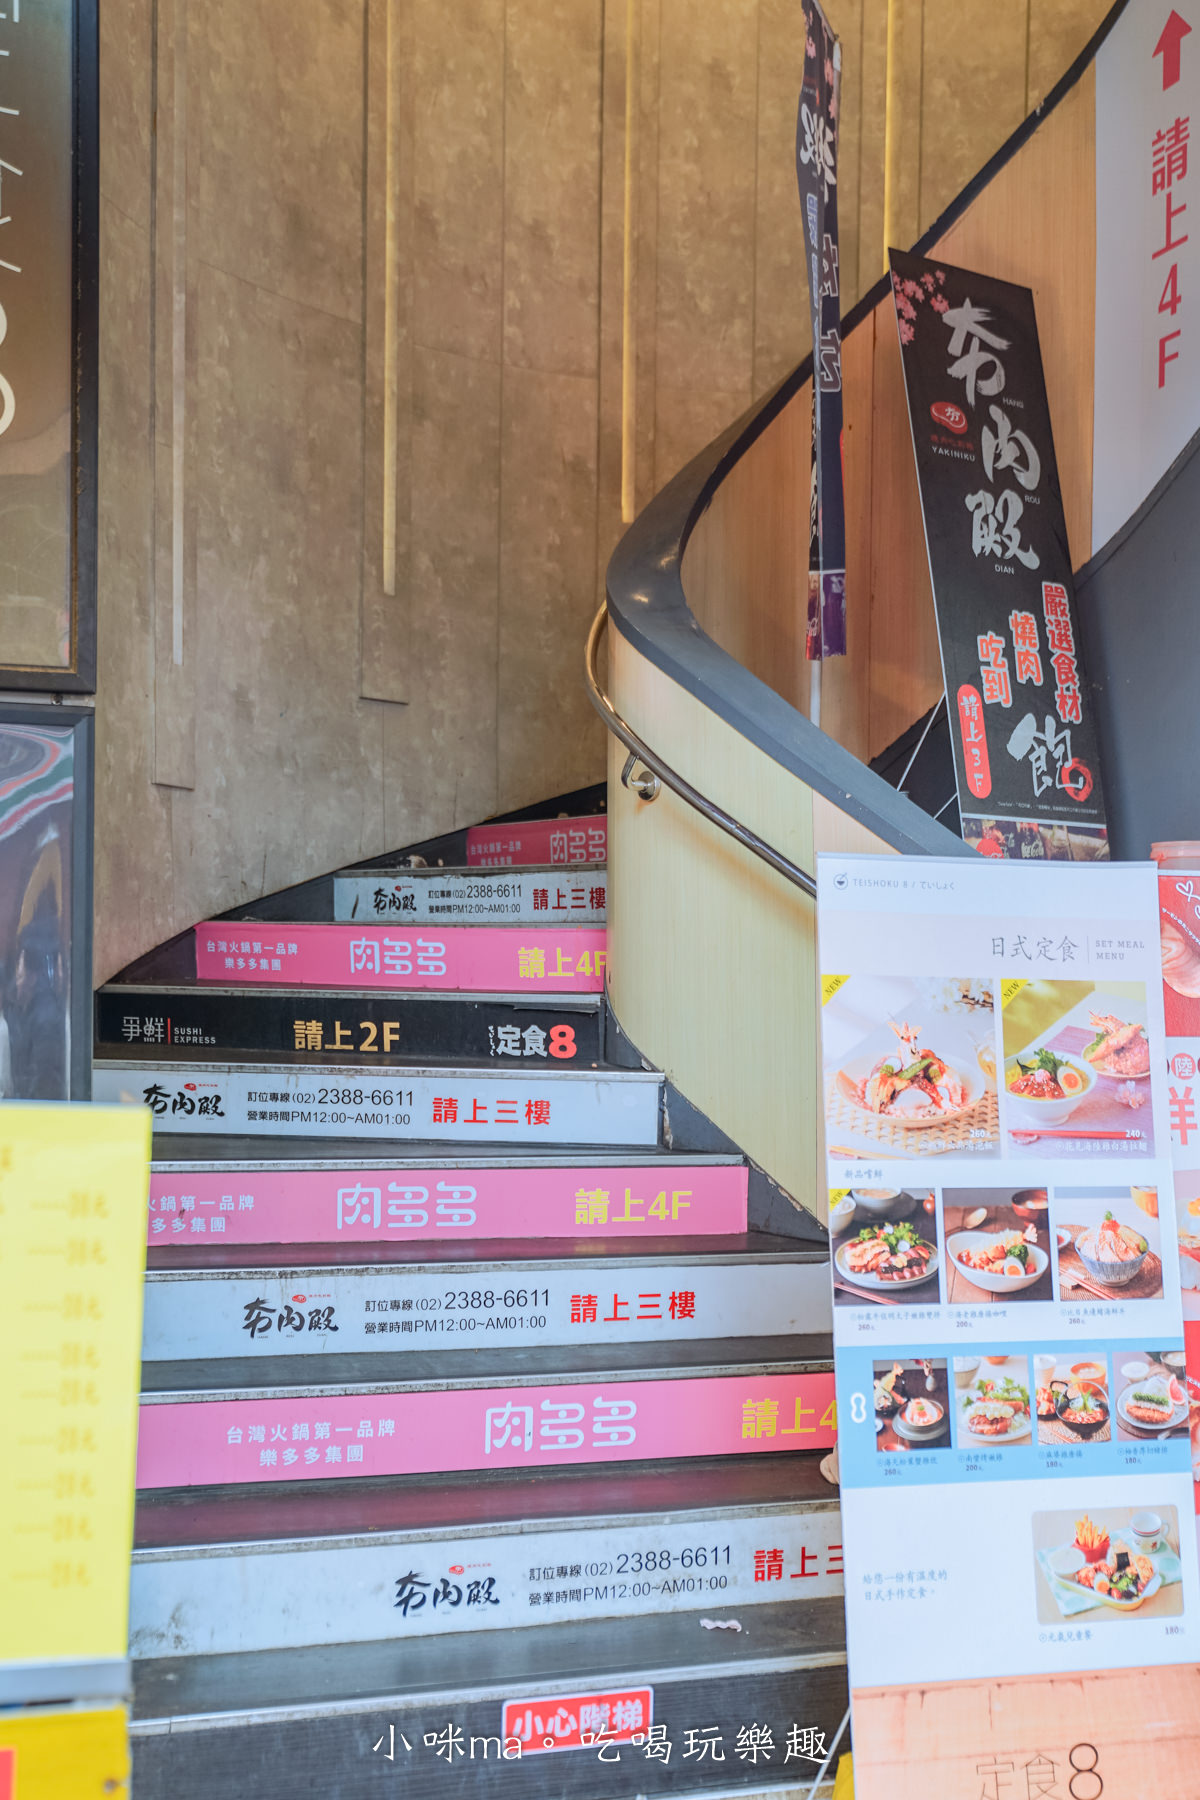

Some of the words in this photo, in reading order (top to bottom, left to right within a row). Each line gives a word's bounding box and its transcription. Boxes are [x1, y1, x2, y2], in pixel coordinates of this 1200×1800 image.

[1151, 116, 1190, 389] 請上4F
[931, 446, 976, 462] YAKINIKU
[1024, 495, 1041, 505] ROU
[994, 564, 1015, 575] DIAN
[1008, 609, 1043, 687] 燒肉
[1042, 581, 1082, 724] 嚴選食材
[977, 631, 1013, 708] 吃到
[960, 694, 984, 793] 請上3F
[1006, 712, 1084, 798] 飽
[550, 827, 606, 864] 肉多多
[852, 878, 899, 888] TEISHOKU
[533, 887, 606, 911] 請上三樓
[206, 940, 299, 955] 台灣火鍋第一品牌
[350, 937, 447, 976] 肉多多
[992, 934, 1079, 963] 日式定食
[1095, 940, 1113, 948] SET
[1117, 940, 1145, 949] MEAL
[1096, 952, 1125, 960] MENU
[224, 957, 282, 971] 樂多多集團
[518, 947, 608, 979] 請上4F
[824, 977, 842, 996] NEW
[1003, 980, 1021, 999] NEW
[174, 1027, 202, 1036] SUSHI
[174, 1036, 216, 1045] EXPRESS
[293, 1020, 400, 1053] 請上2F
[496, 1024, 577, 1059] 定食8
[432, 1097, 551, 1126] 請上三樓
[337, 1181, 477, 1230] 肉多多
[575, 1188, 693, 1225] 請上4F
[570, 1291, 697, 1324] 請上三樓
[226, 1419, 395, 1445] 台灣火鍋第一品牌
[485, 1396, 637, 1454] 肉多多
[259, 1445, 364, 1467] 樂多多集團
[512, 1698, 644, 1741] 小心階梯
